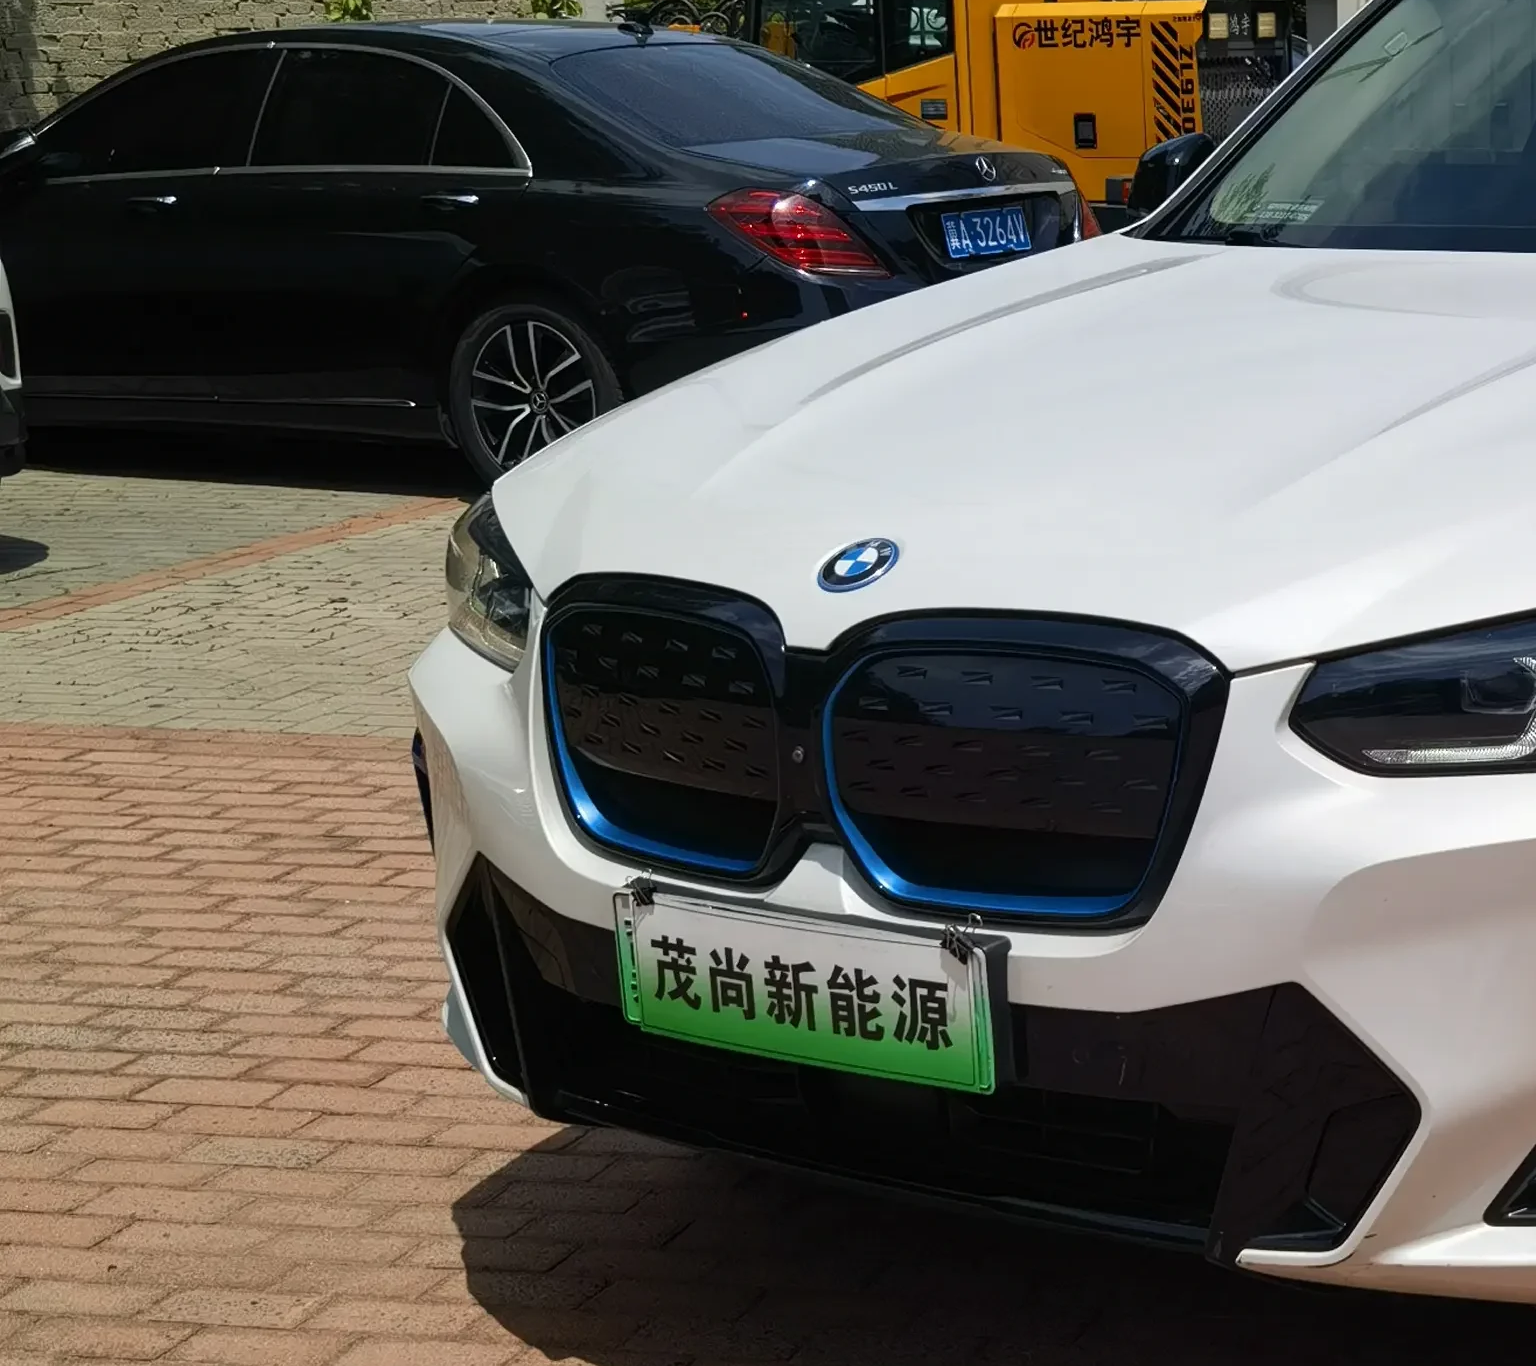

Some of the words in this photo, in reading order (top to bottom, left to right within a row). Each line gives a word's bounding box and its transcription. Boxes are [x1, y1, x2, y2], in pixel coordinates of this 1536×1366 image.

[1034, 16, 1142, 50] 世纪鸿宇
[649, 934, 954, 1052] 茂尚新能源
